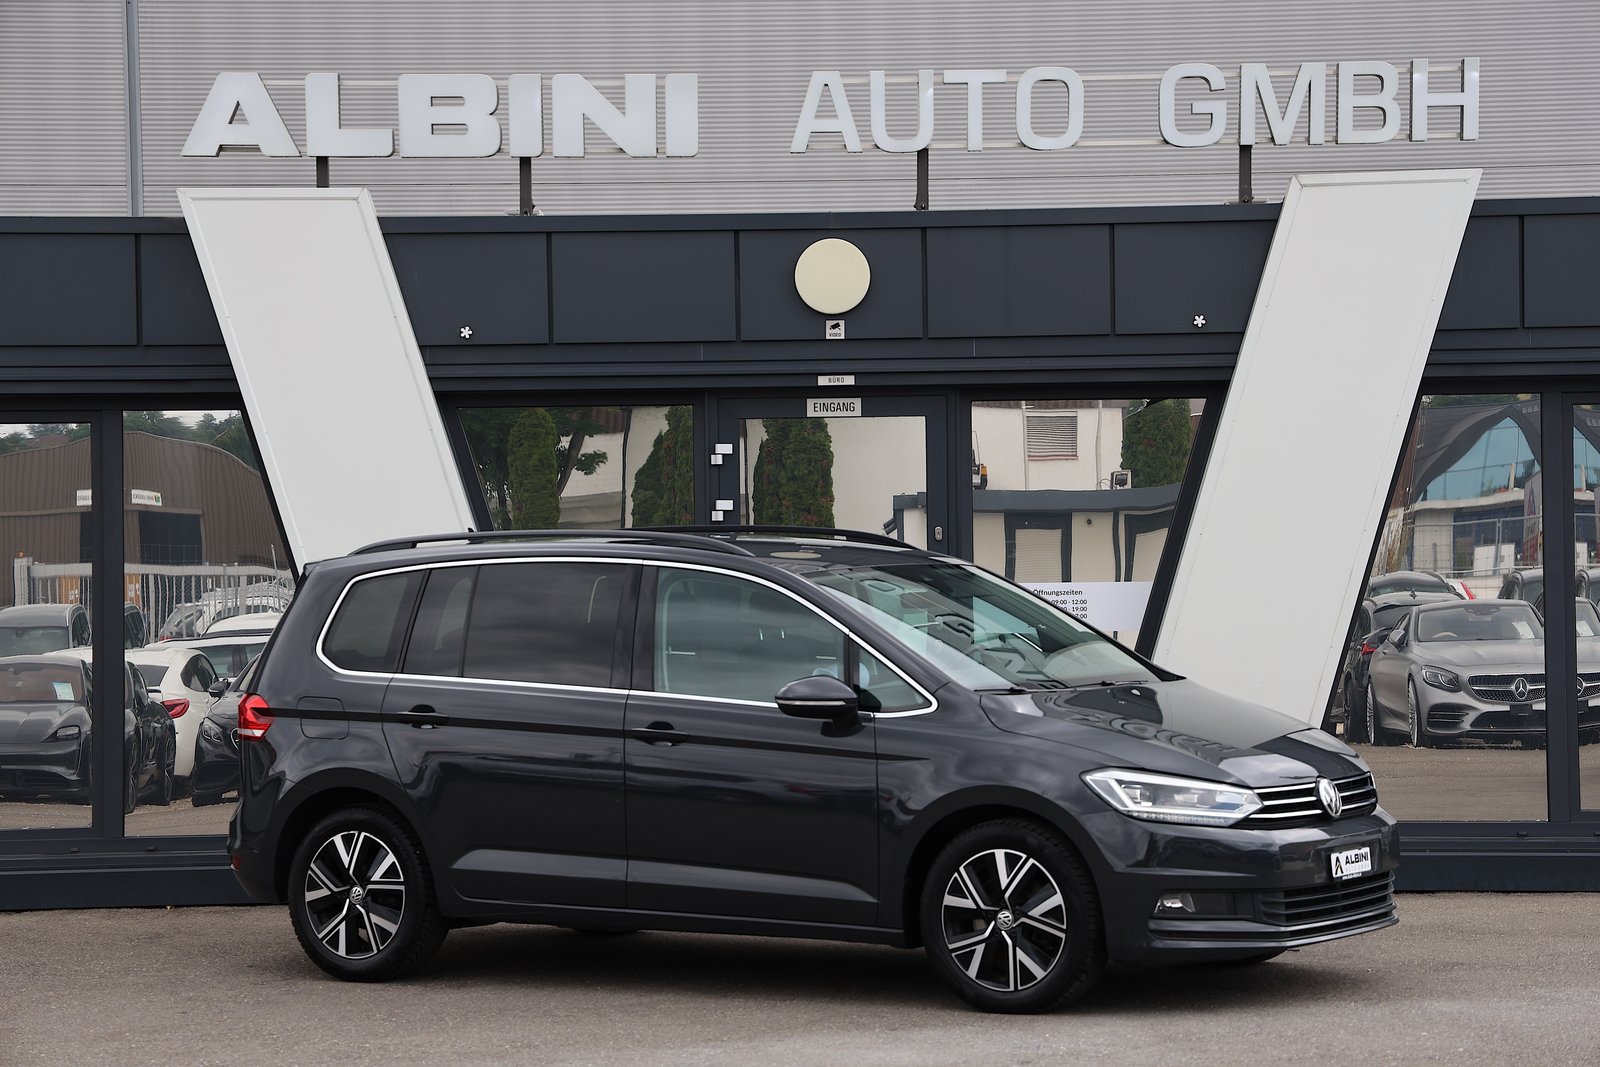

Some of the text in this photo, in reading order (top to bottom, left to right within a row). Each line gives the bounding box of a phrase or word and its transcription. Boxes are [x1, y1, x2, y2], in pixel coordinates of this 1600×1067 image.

[180, 56, 1480, 158] ALBINI AUTO GMBH
[828, 376, 845, 384] BÜRO
[814, 402, 856, 412] EINGANG
[1345, 852, 1368, 866] ALBINI
